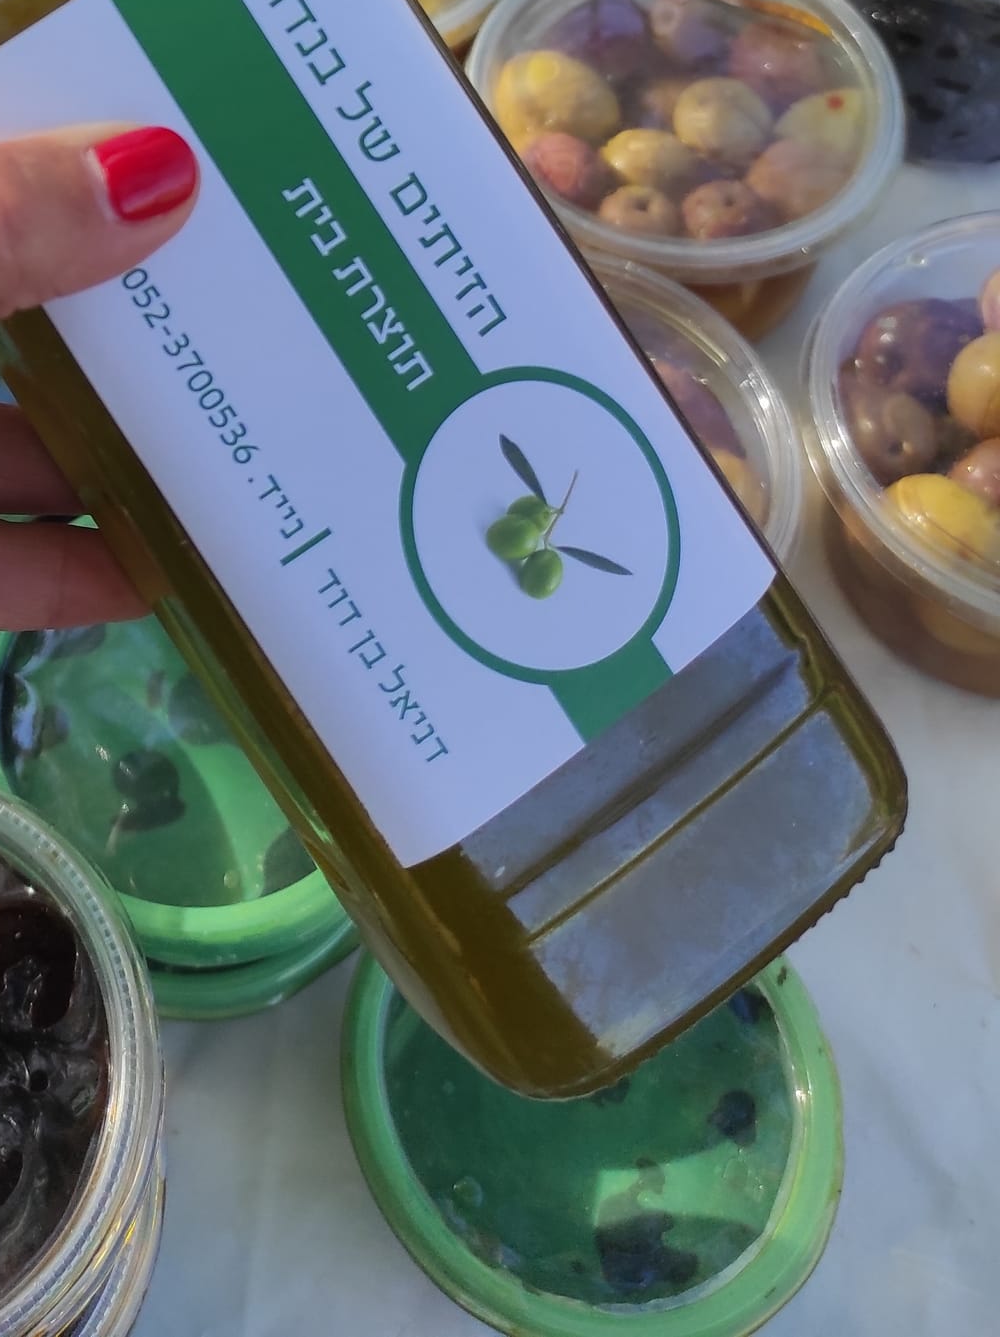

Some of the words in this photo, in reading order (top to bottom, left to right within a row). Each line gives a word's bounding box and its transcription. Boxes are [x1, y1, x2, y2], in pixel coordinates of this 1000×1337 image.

[335, 79, 402, 164] של
[281, 176, 348, 257] בית
[388, 170, 507, 337] הזיתים
[120, 266, 260, 466] 052-3700536
[331, 256, 434, 391] תוצרת
[317, 566, 363, 628] דוד
[347, 628, 388, 671] בן
[377, 662, 450, 764] דניאל
